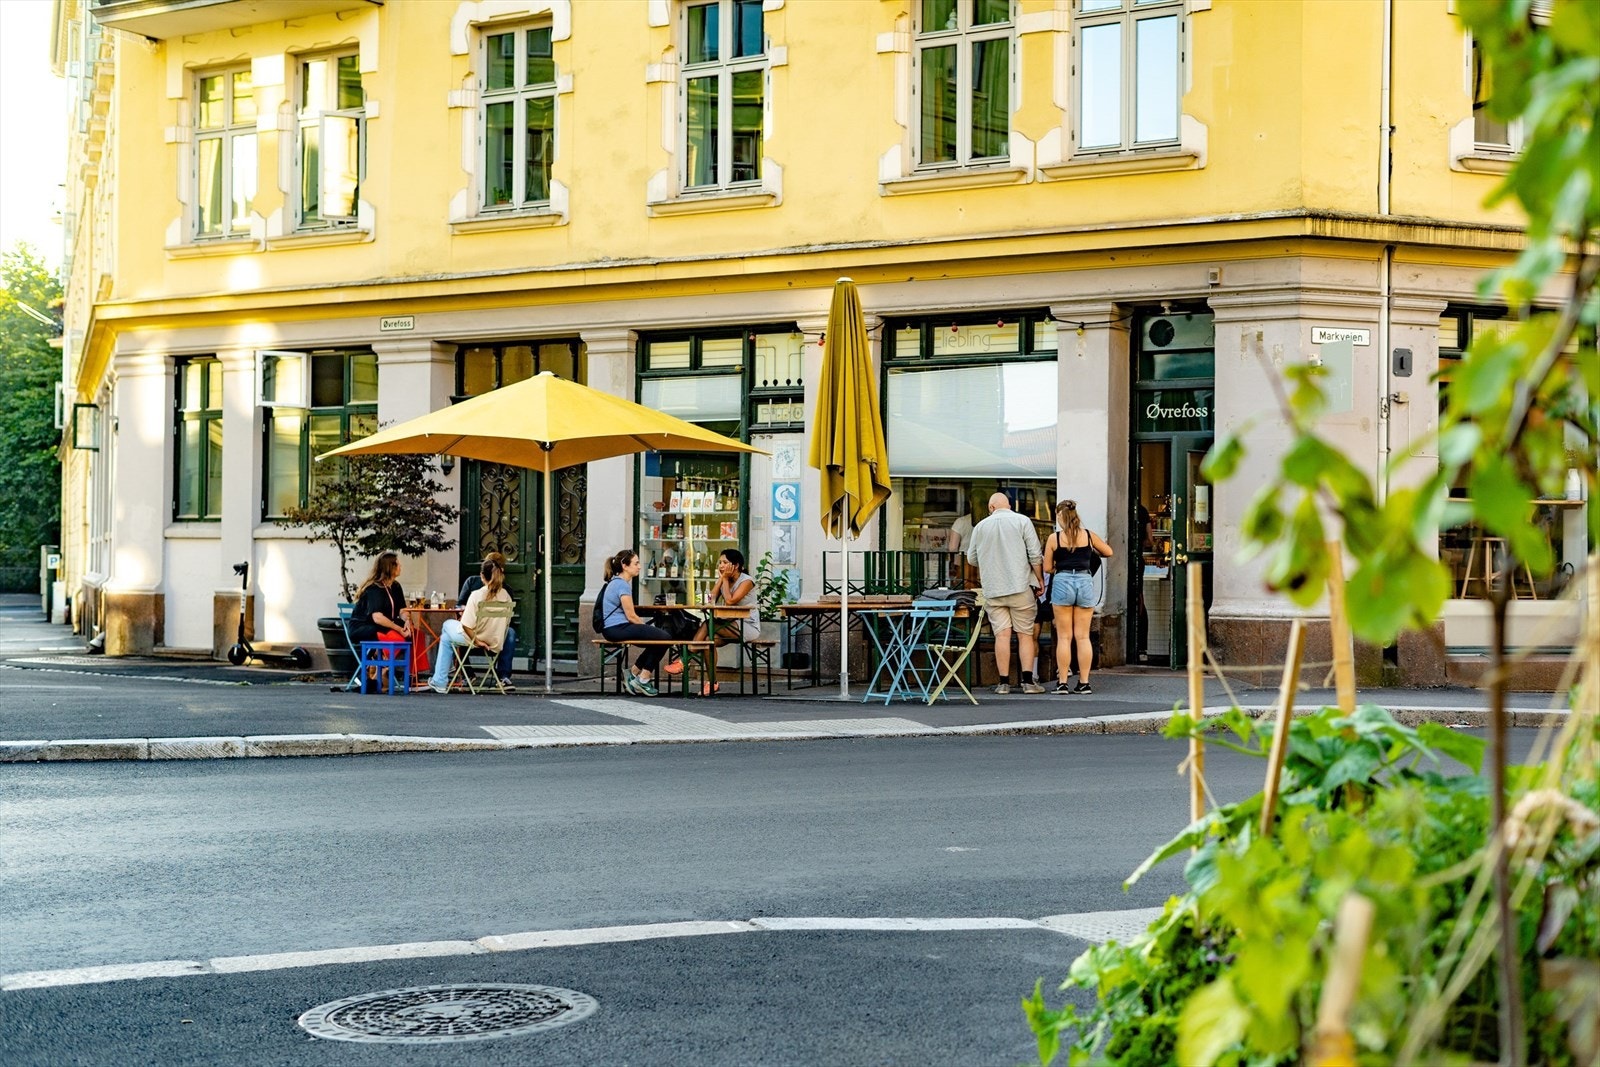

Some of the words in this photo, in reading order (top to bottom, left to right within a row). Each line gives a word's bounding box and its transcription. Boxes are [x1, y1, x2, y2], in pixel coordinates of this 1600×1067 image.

[383, 319, 411, 328] Øvrefoss
[942, 328, 991, 352] liebling
[1319, 331, 1363, 342] Markveien
[1146, 402, 1208, 419] Øvrefoss
[774, 484, 797, 520] S
[50, 556, 58, 566] P
